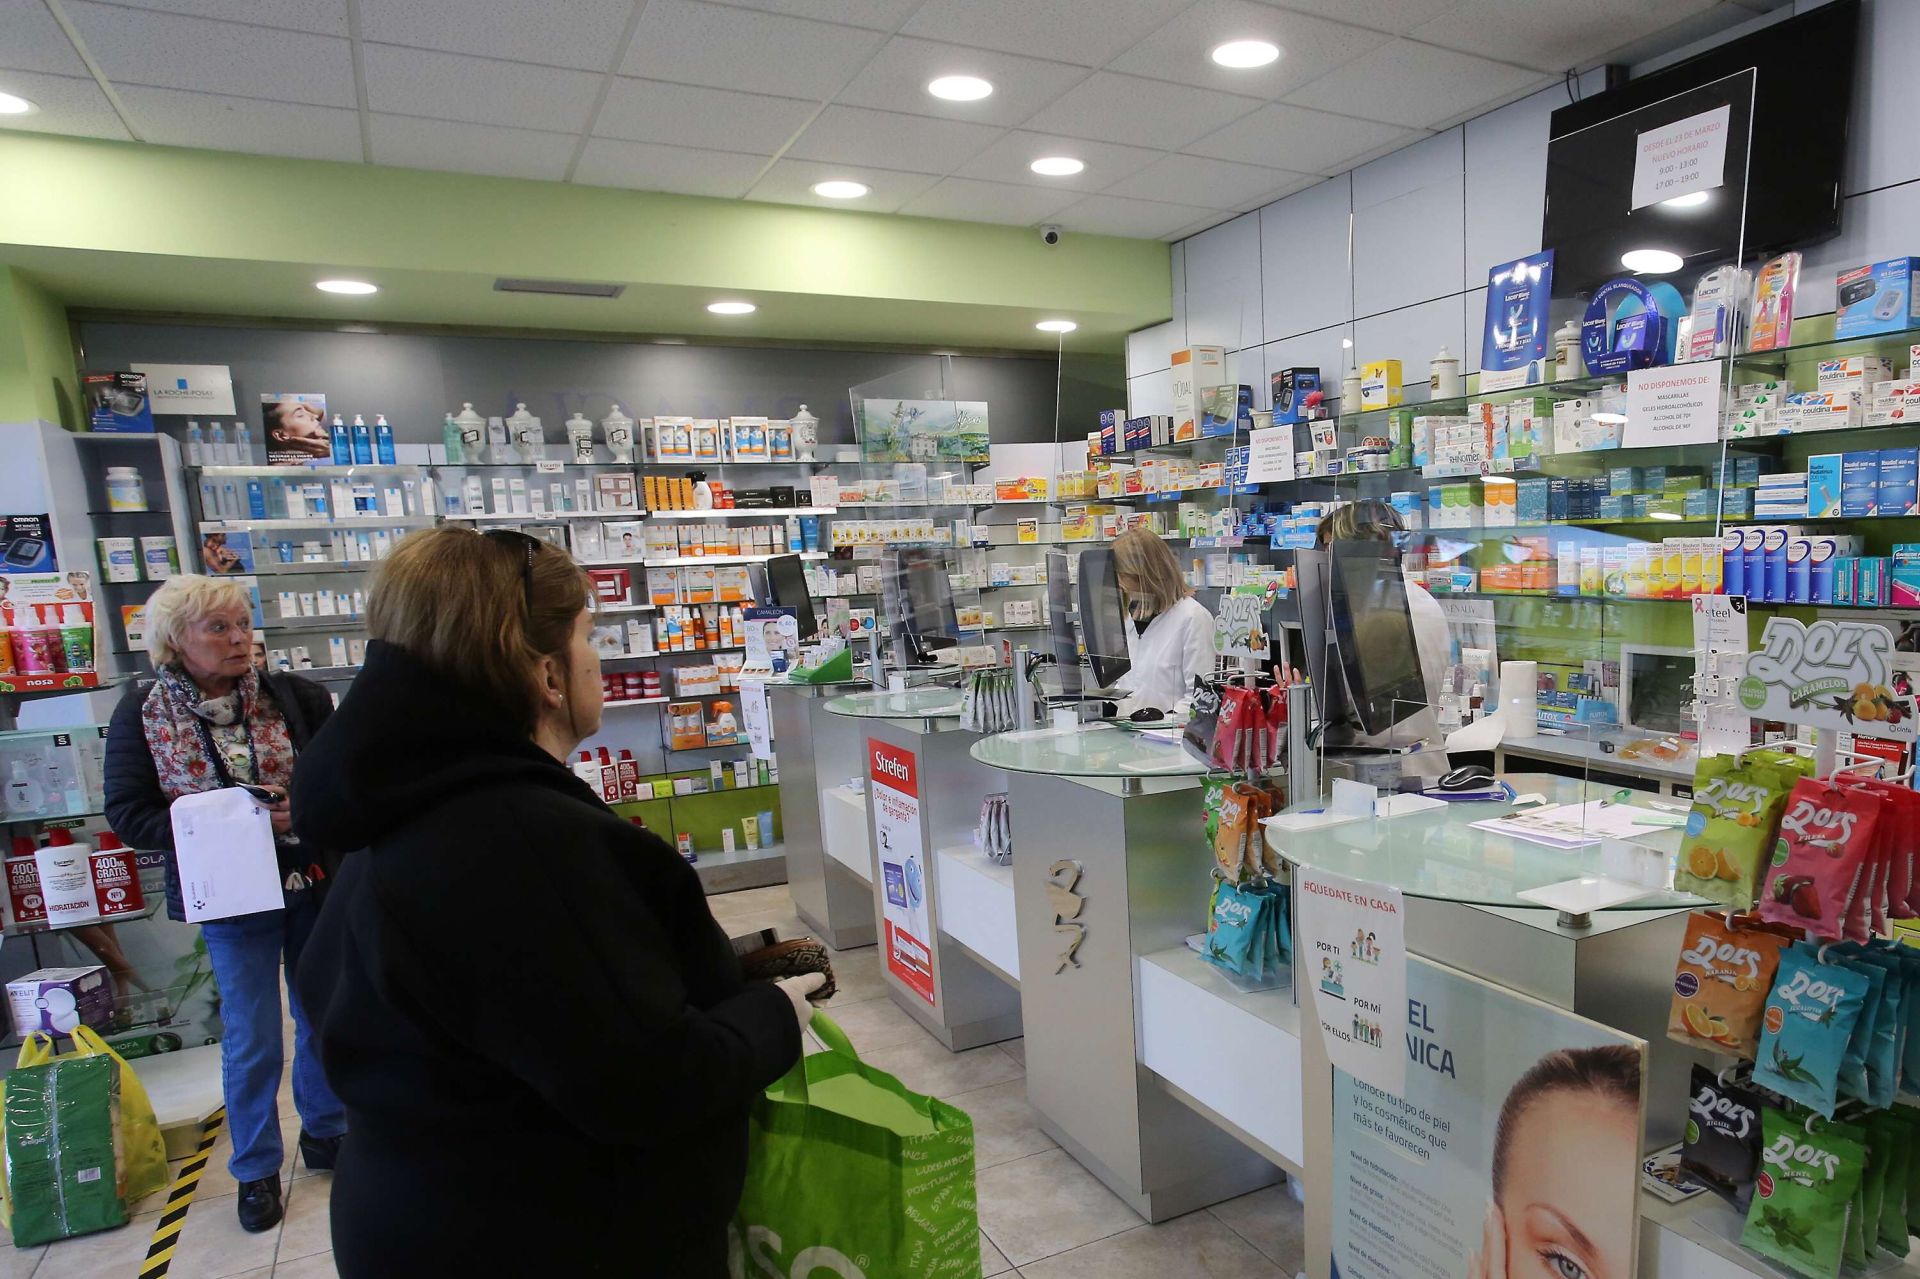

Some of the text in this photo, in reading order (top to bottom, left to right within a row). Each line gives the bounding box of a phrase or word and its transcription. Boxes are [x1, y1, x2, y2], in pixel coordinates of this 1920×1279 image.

[1698, 287, 1721, 297] Lacer
[1638, 382, 1649, 391] NO
[1650, 377, 1698, 391] DISPONEMOS
[1819, 371, 1845, 381] couldina
[1802, 405, 1831, 415] couldina
[1791, 678, 1847, 703] CARAMELOS
[875, 750, 909, 783] Strefen
[96, 857, 126, 869] 400ML
[97, 866, 128, 878] GRATIS
[1303, 880, 1397, 914] #QUEDATE EN CASA
[1316, 940, 1340, 956] POR TI
[1353, 996, 1369, 1010] POR
[1408, 998, 1435, 1034] EL
[1332, 1026, 1351, 1043] ELLOS
[1406, 1031, 1456, 1080] NICA
[1353, 1077, 1451, 1134] Conoce tu tipo de piel
[1360, 1096, 1373, 1112] los
[1374, 1105, 1426, 1140] cosméticos
[1428, 1134, 1447, 1151] que
[1353, 1111, 1430, 1161] más te favorecen
